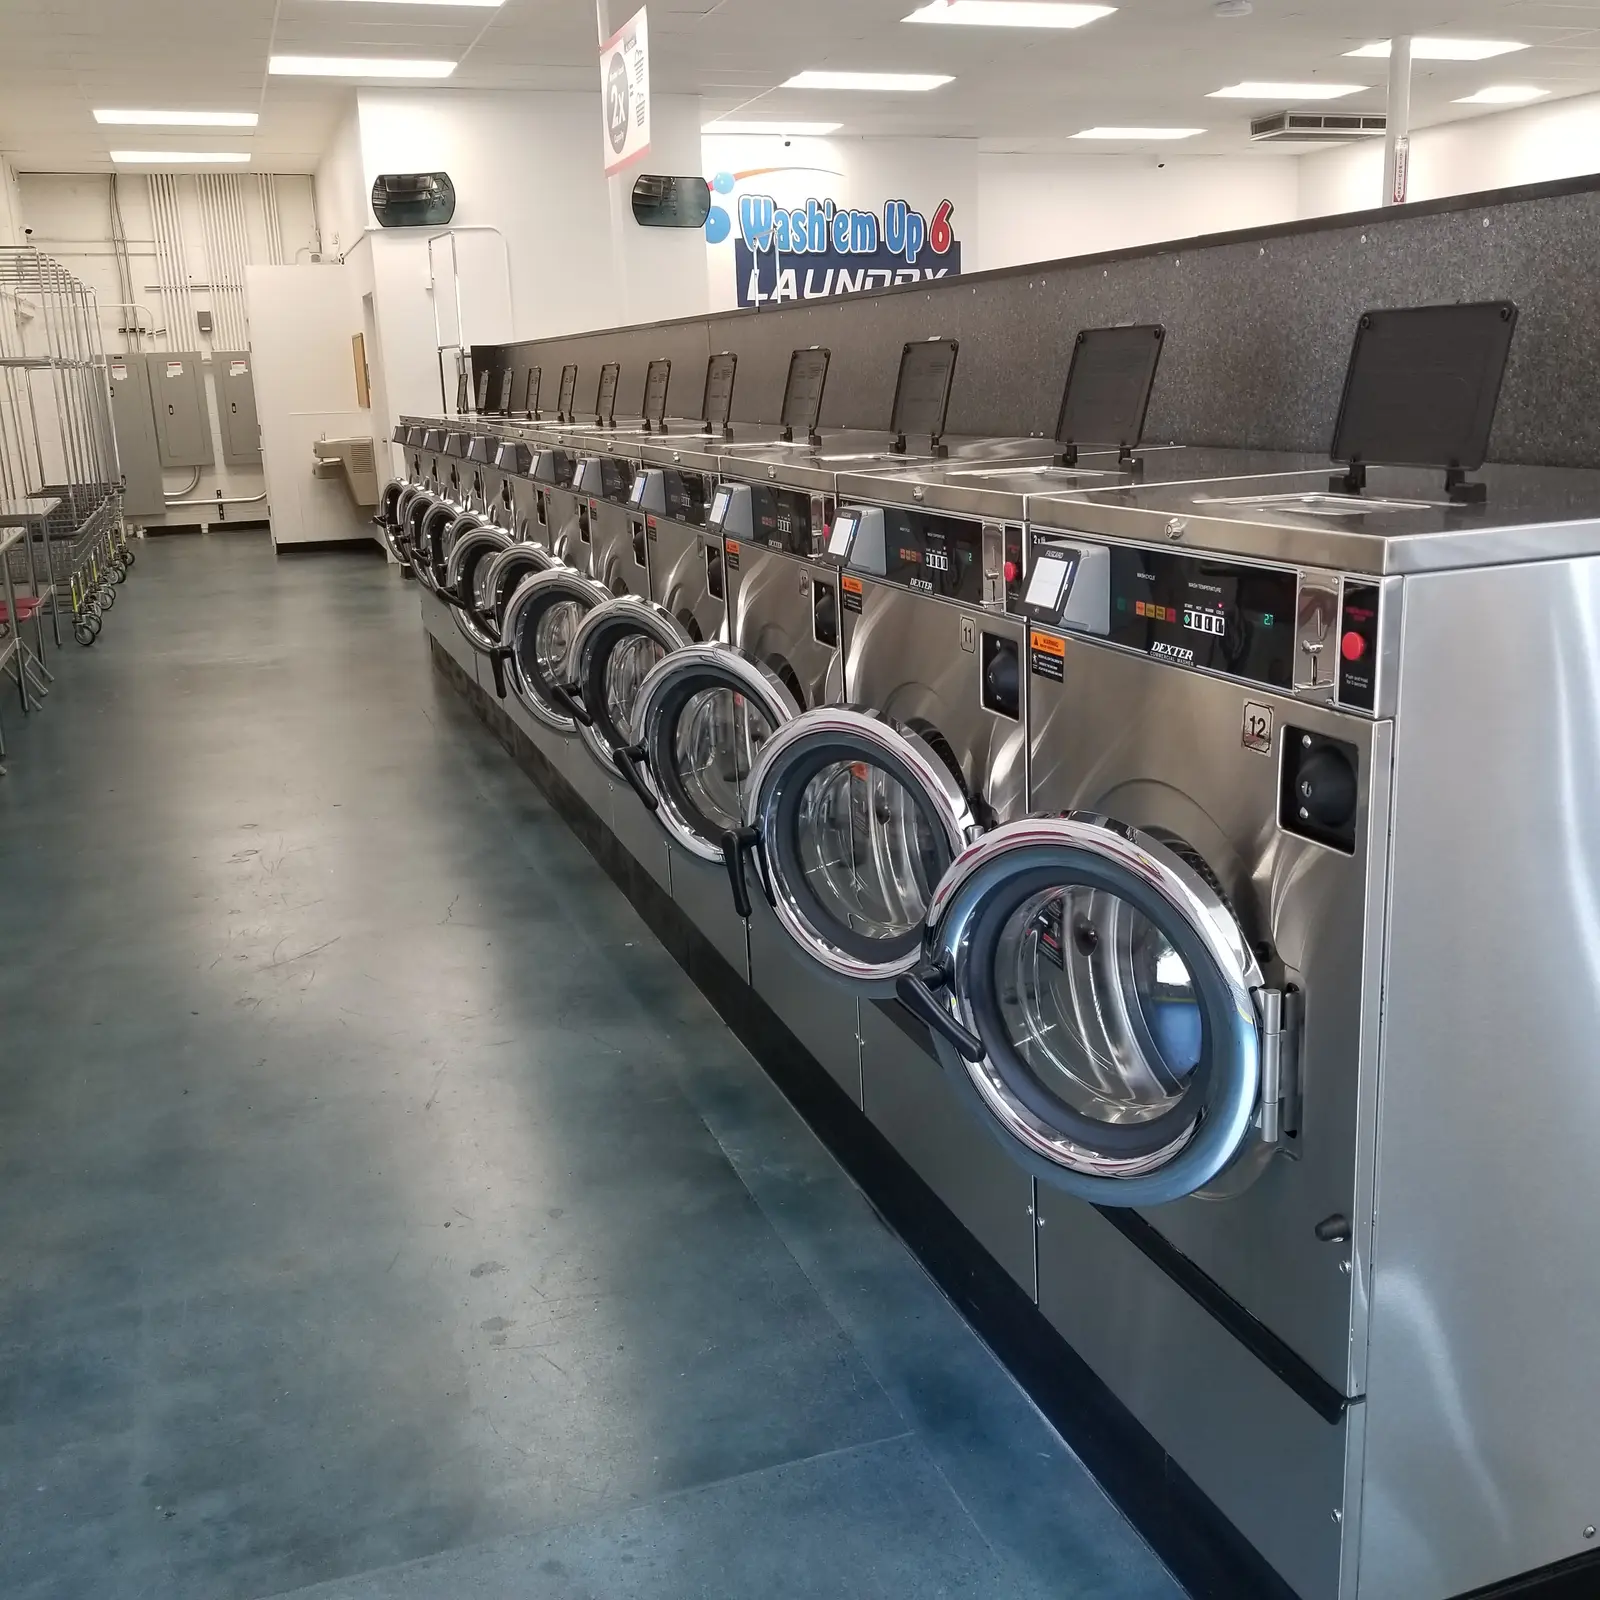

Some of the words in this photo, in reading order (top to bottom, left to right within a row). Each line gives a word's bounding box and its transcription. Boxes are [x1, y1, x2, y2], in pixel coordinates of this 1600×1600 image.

[738, 194, 879, 255] Wash'em
[884, 198, 927, 264] Up
[929, 198, 954, 255] 6
[909, 577, 933, 591] DEXTER
[963, 626, 973, 643] 11
[1151, 641, 1194, 661] DEXTER
[1249, 715, 1266, 739] 12
